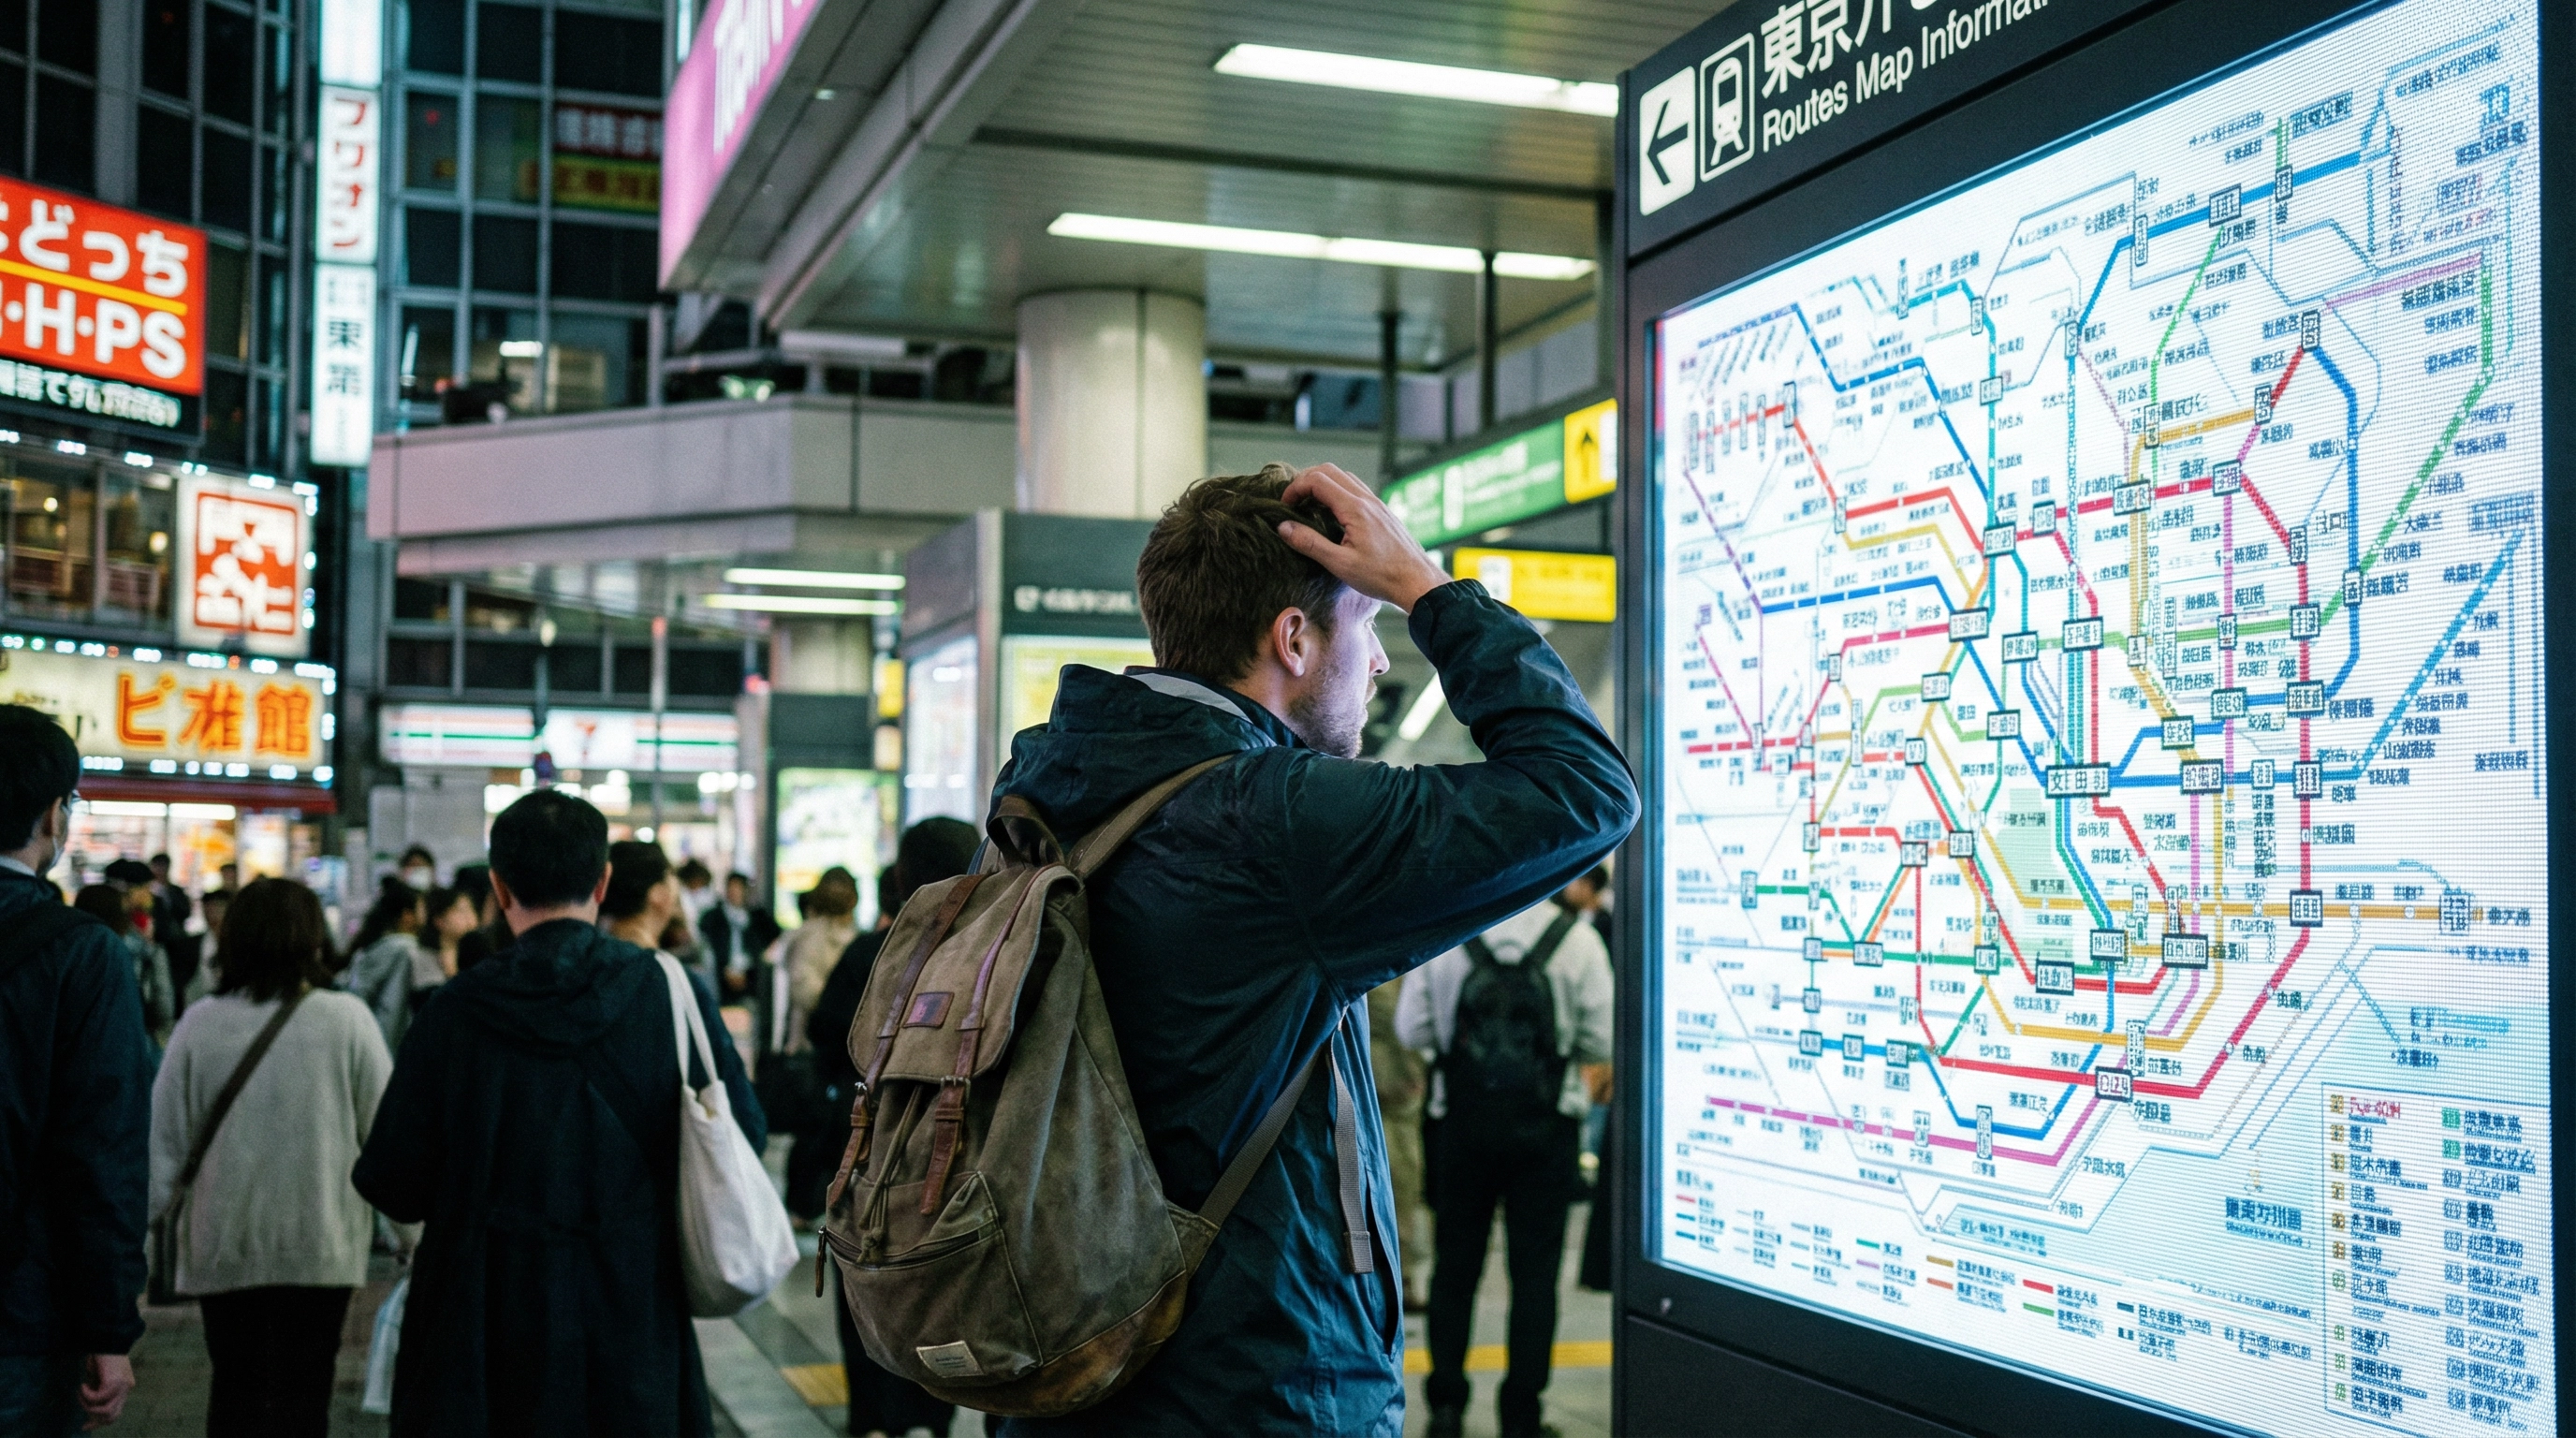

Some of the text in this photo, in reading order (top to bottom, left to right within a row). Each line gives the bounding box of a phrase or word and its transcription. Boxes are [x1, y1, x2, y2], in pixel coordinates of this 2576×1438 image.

[1763, 0, 2049, 154] Routes Map Informa
